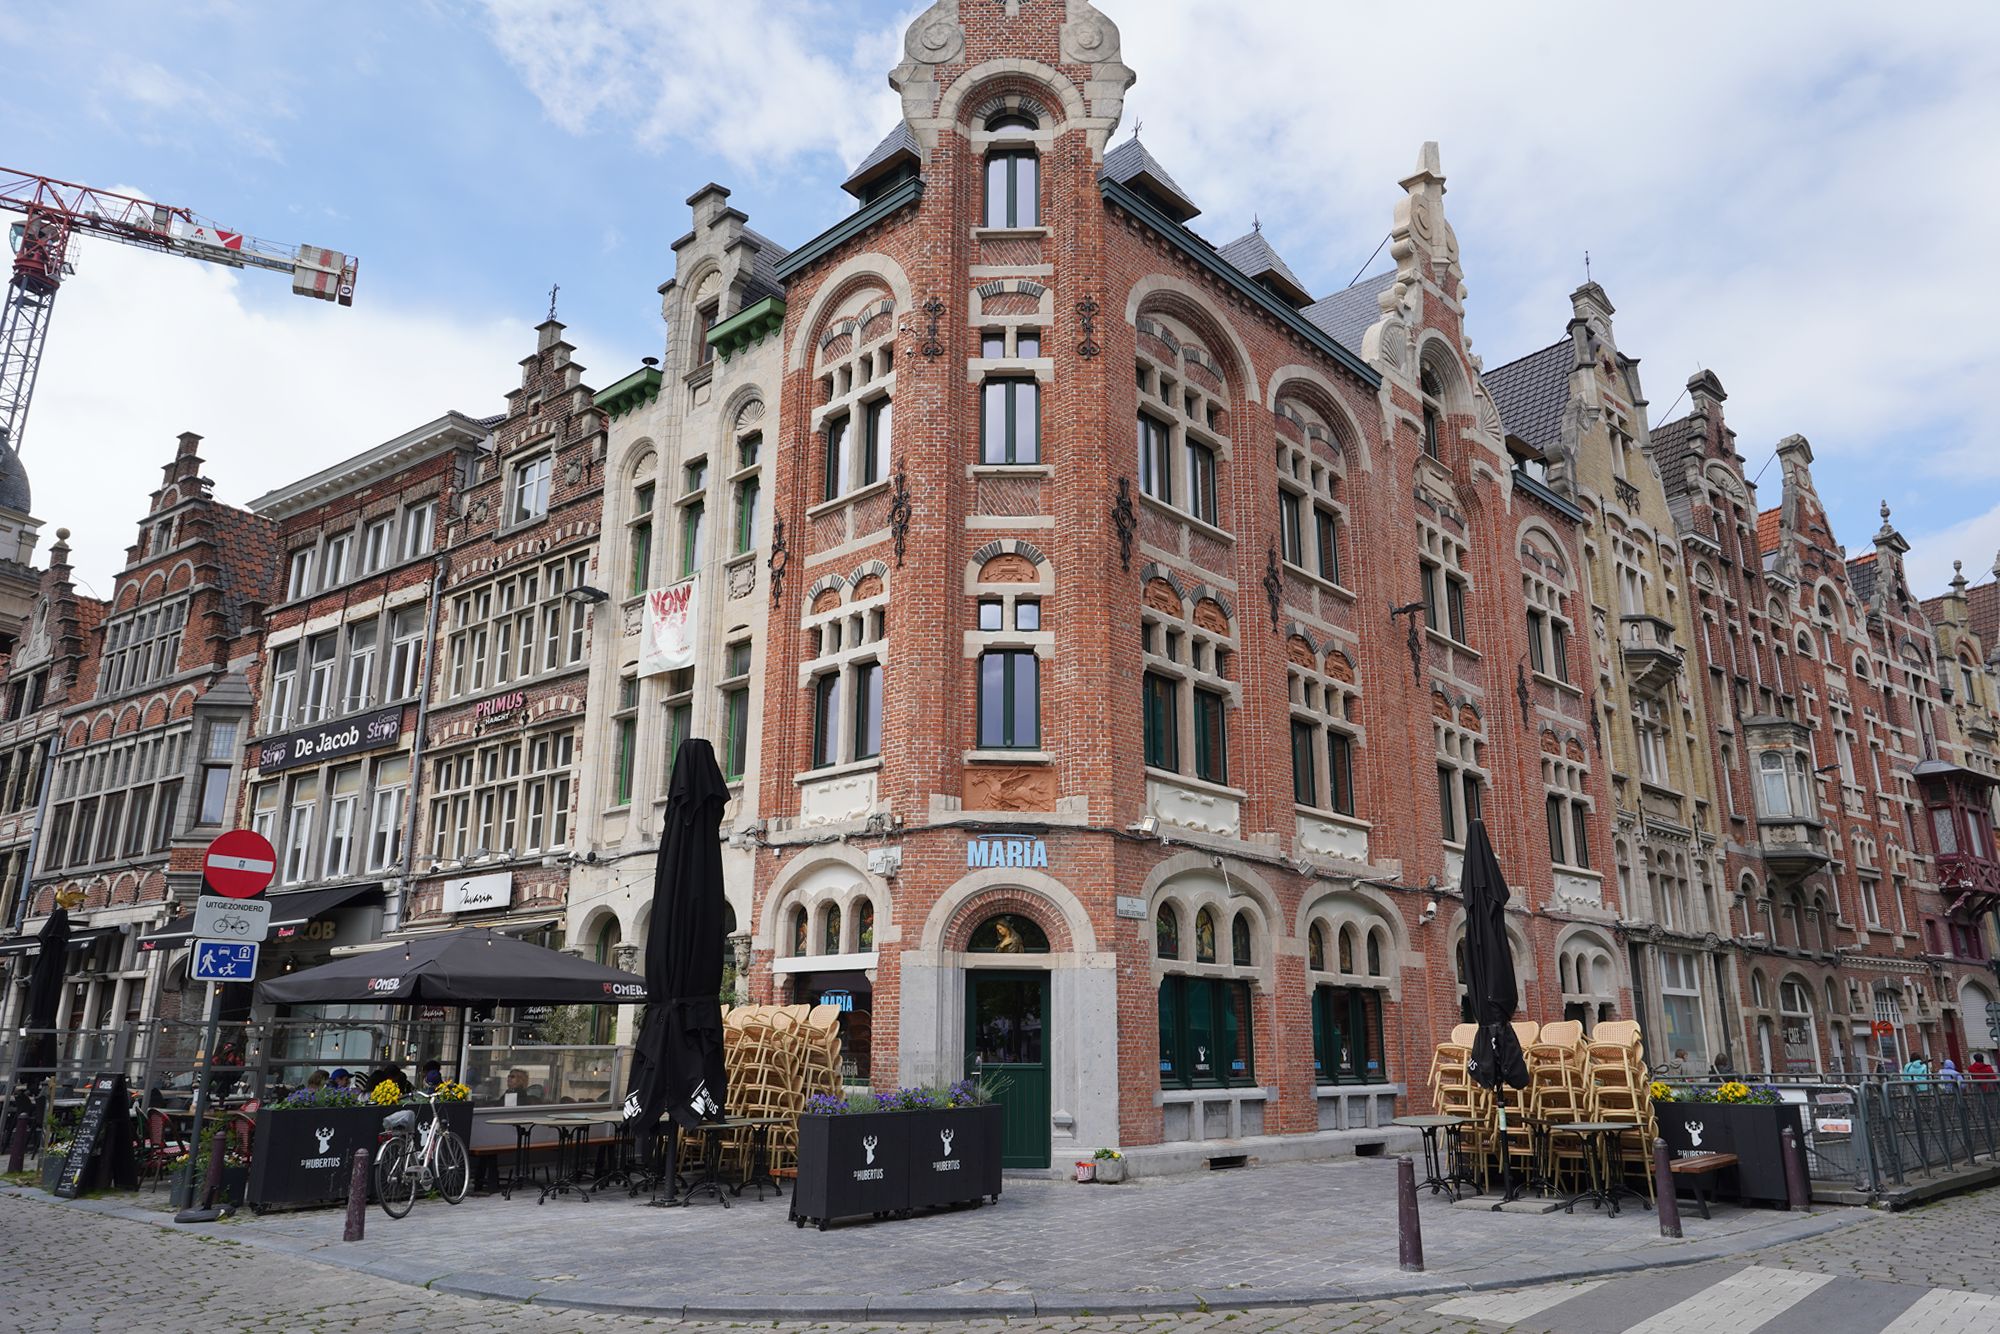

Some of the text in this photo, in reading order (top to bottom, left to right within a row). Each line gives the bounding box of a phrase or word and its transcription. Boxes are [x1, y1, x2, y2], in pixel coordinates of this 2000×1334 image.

[476, 691, 524, 719] PRIMUS
[294, 725, 360, 759] De Jacob
[367, 720, 398, 750] Strop
[260, 747, 287, 767] Strop
[460, 881, 493, 905] Savarin
[205, 901, 265, 913] UITGEZONDERD
[305, 1157, 340, 1169] HUBERTUS
[936, 1160, 960, 1172] HUBERTUS
[857, 1168, 884, 1181] HUBERTUS
